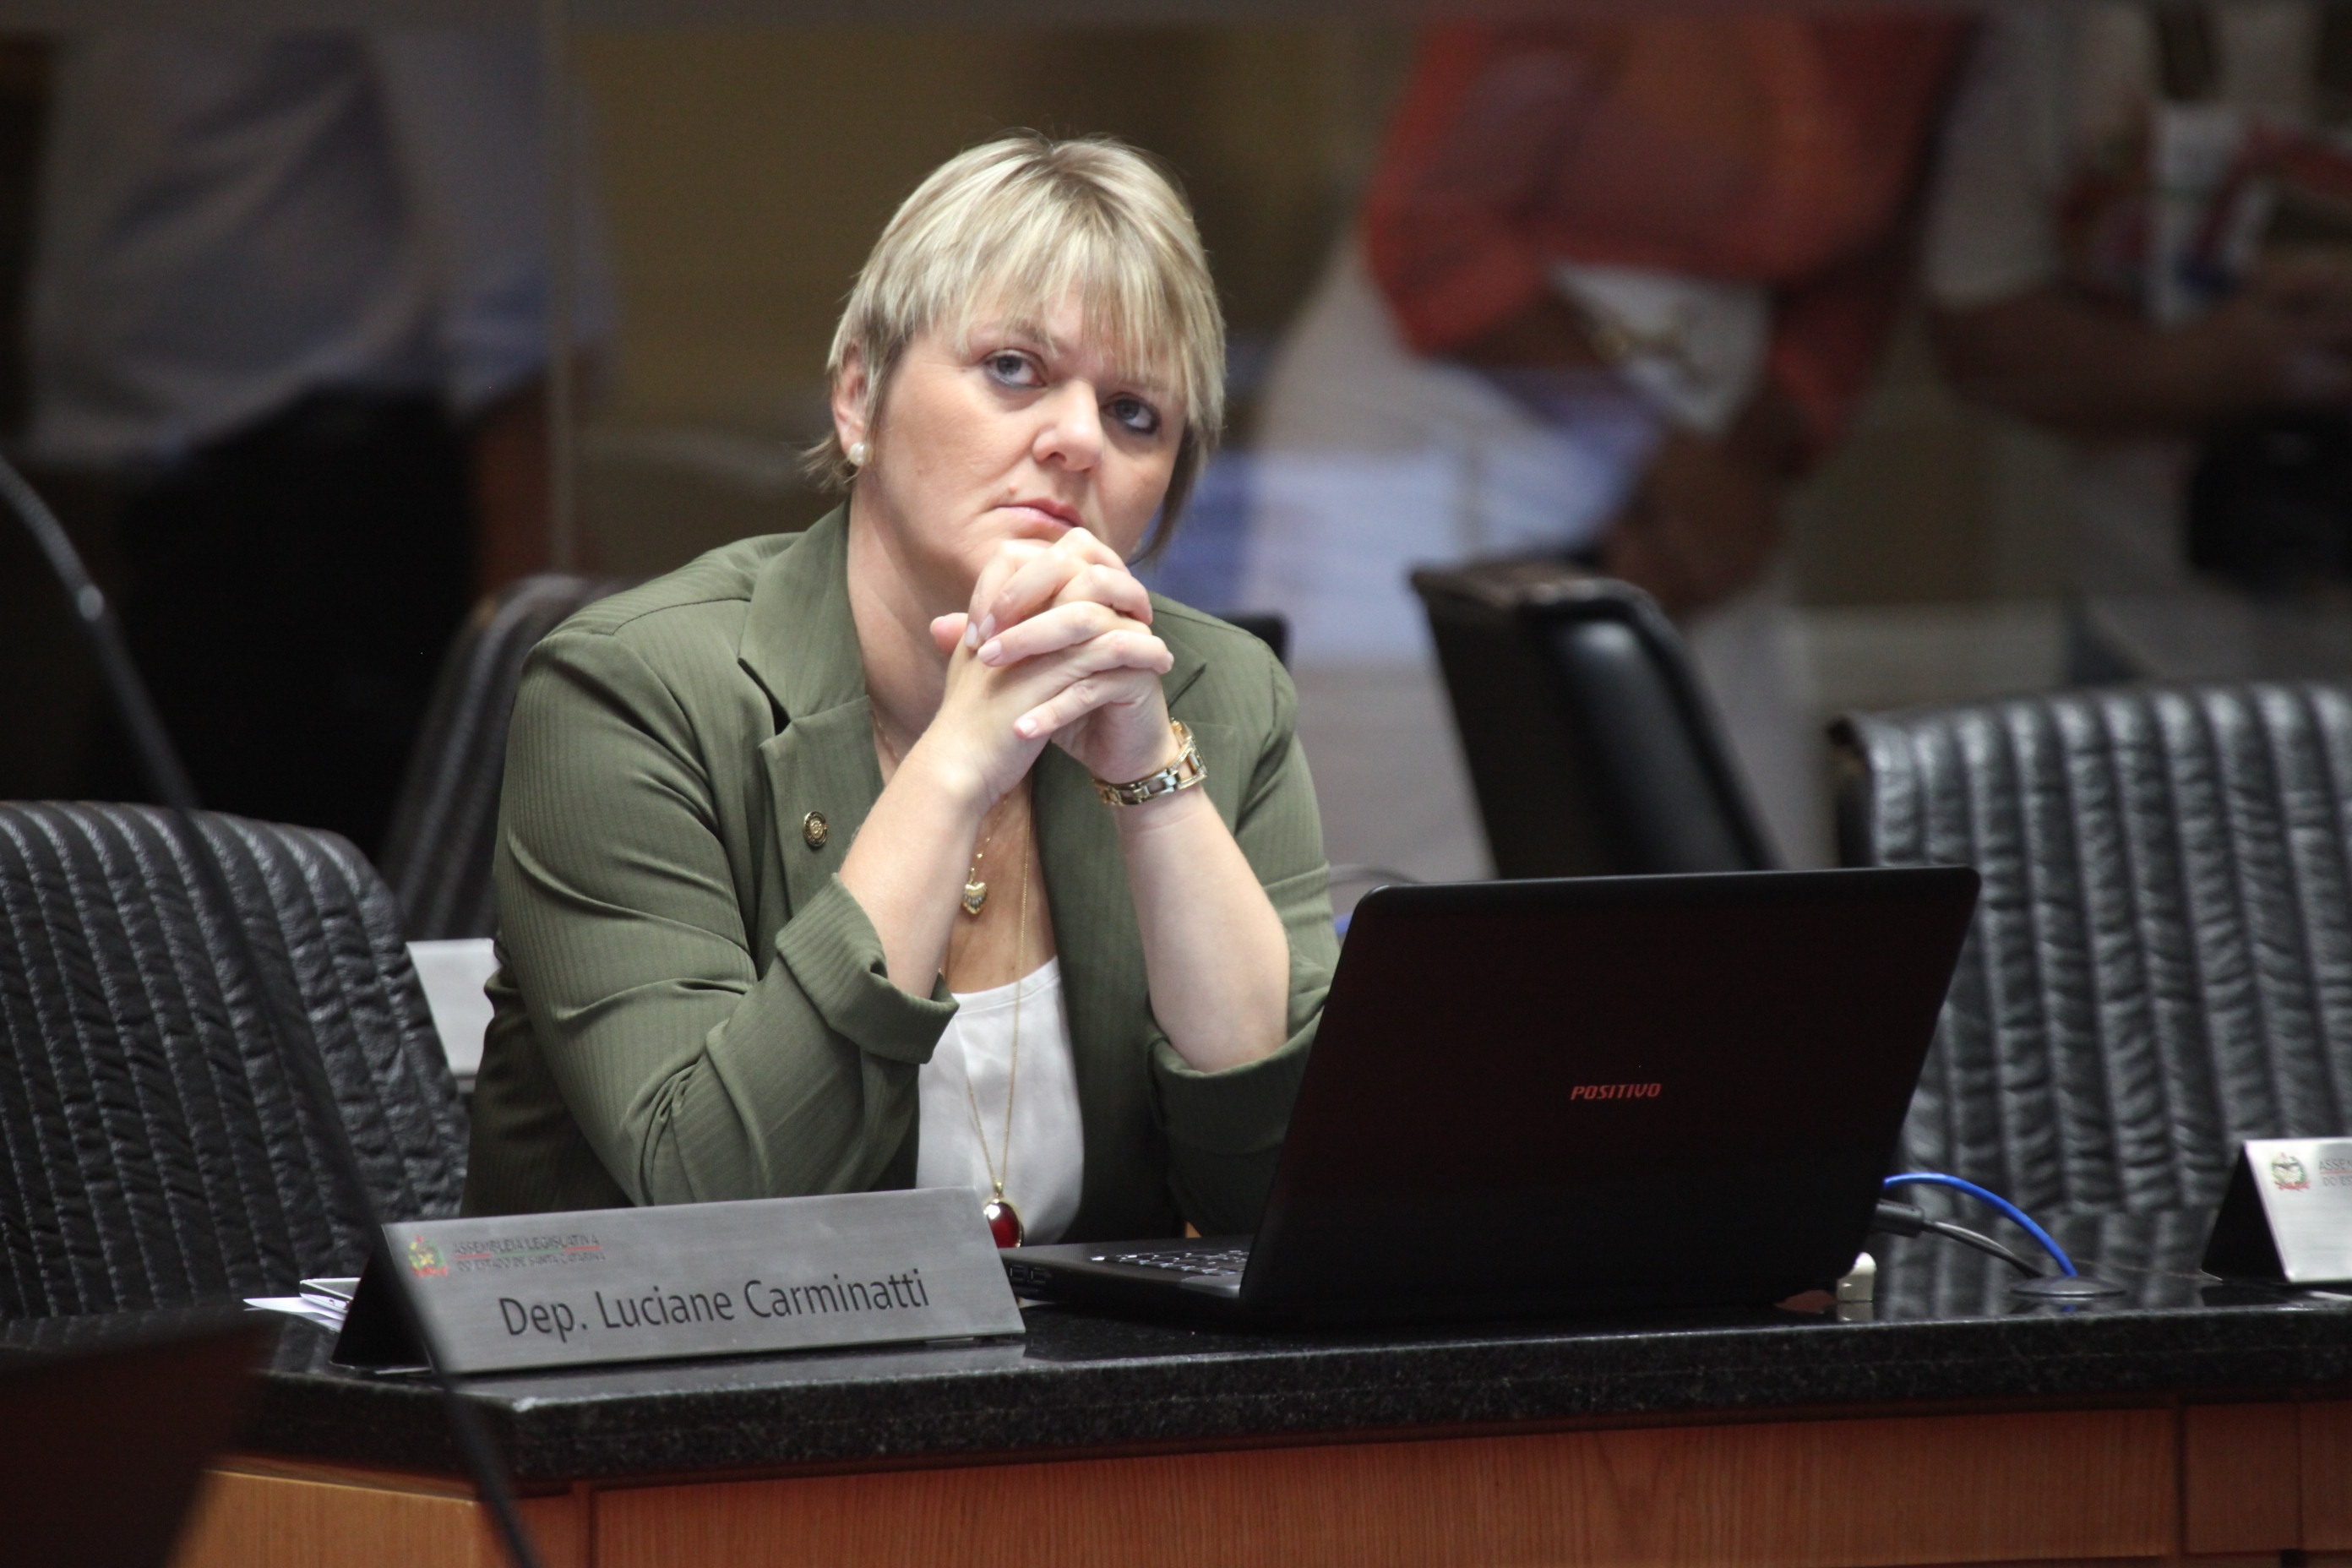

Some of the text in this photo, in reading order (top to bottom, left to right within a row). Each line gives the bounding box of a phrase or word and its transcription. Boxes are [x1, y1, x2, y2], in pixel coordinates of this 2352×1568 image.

[1570, 1082, 1662, 1100] POSITIVO
[498, 1268, 930, 1343] Dep. Luciane Carminatti
